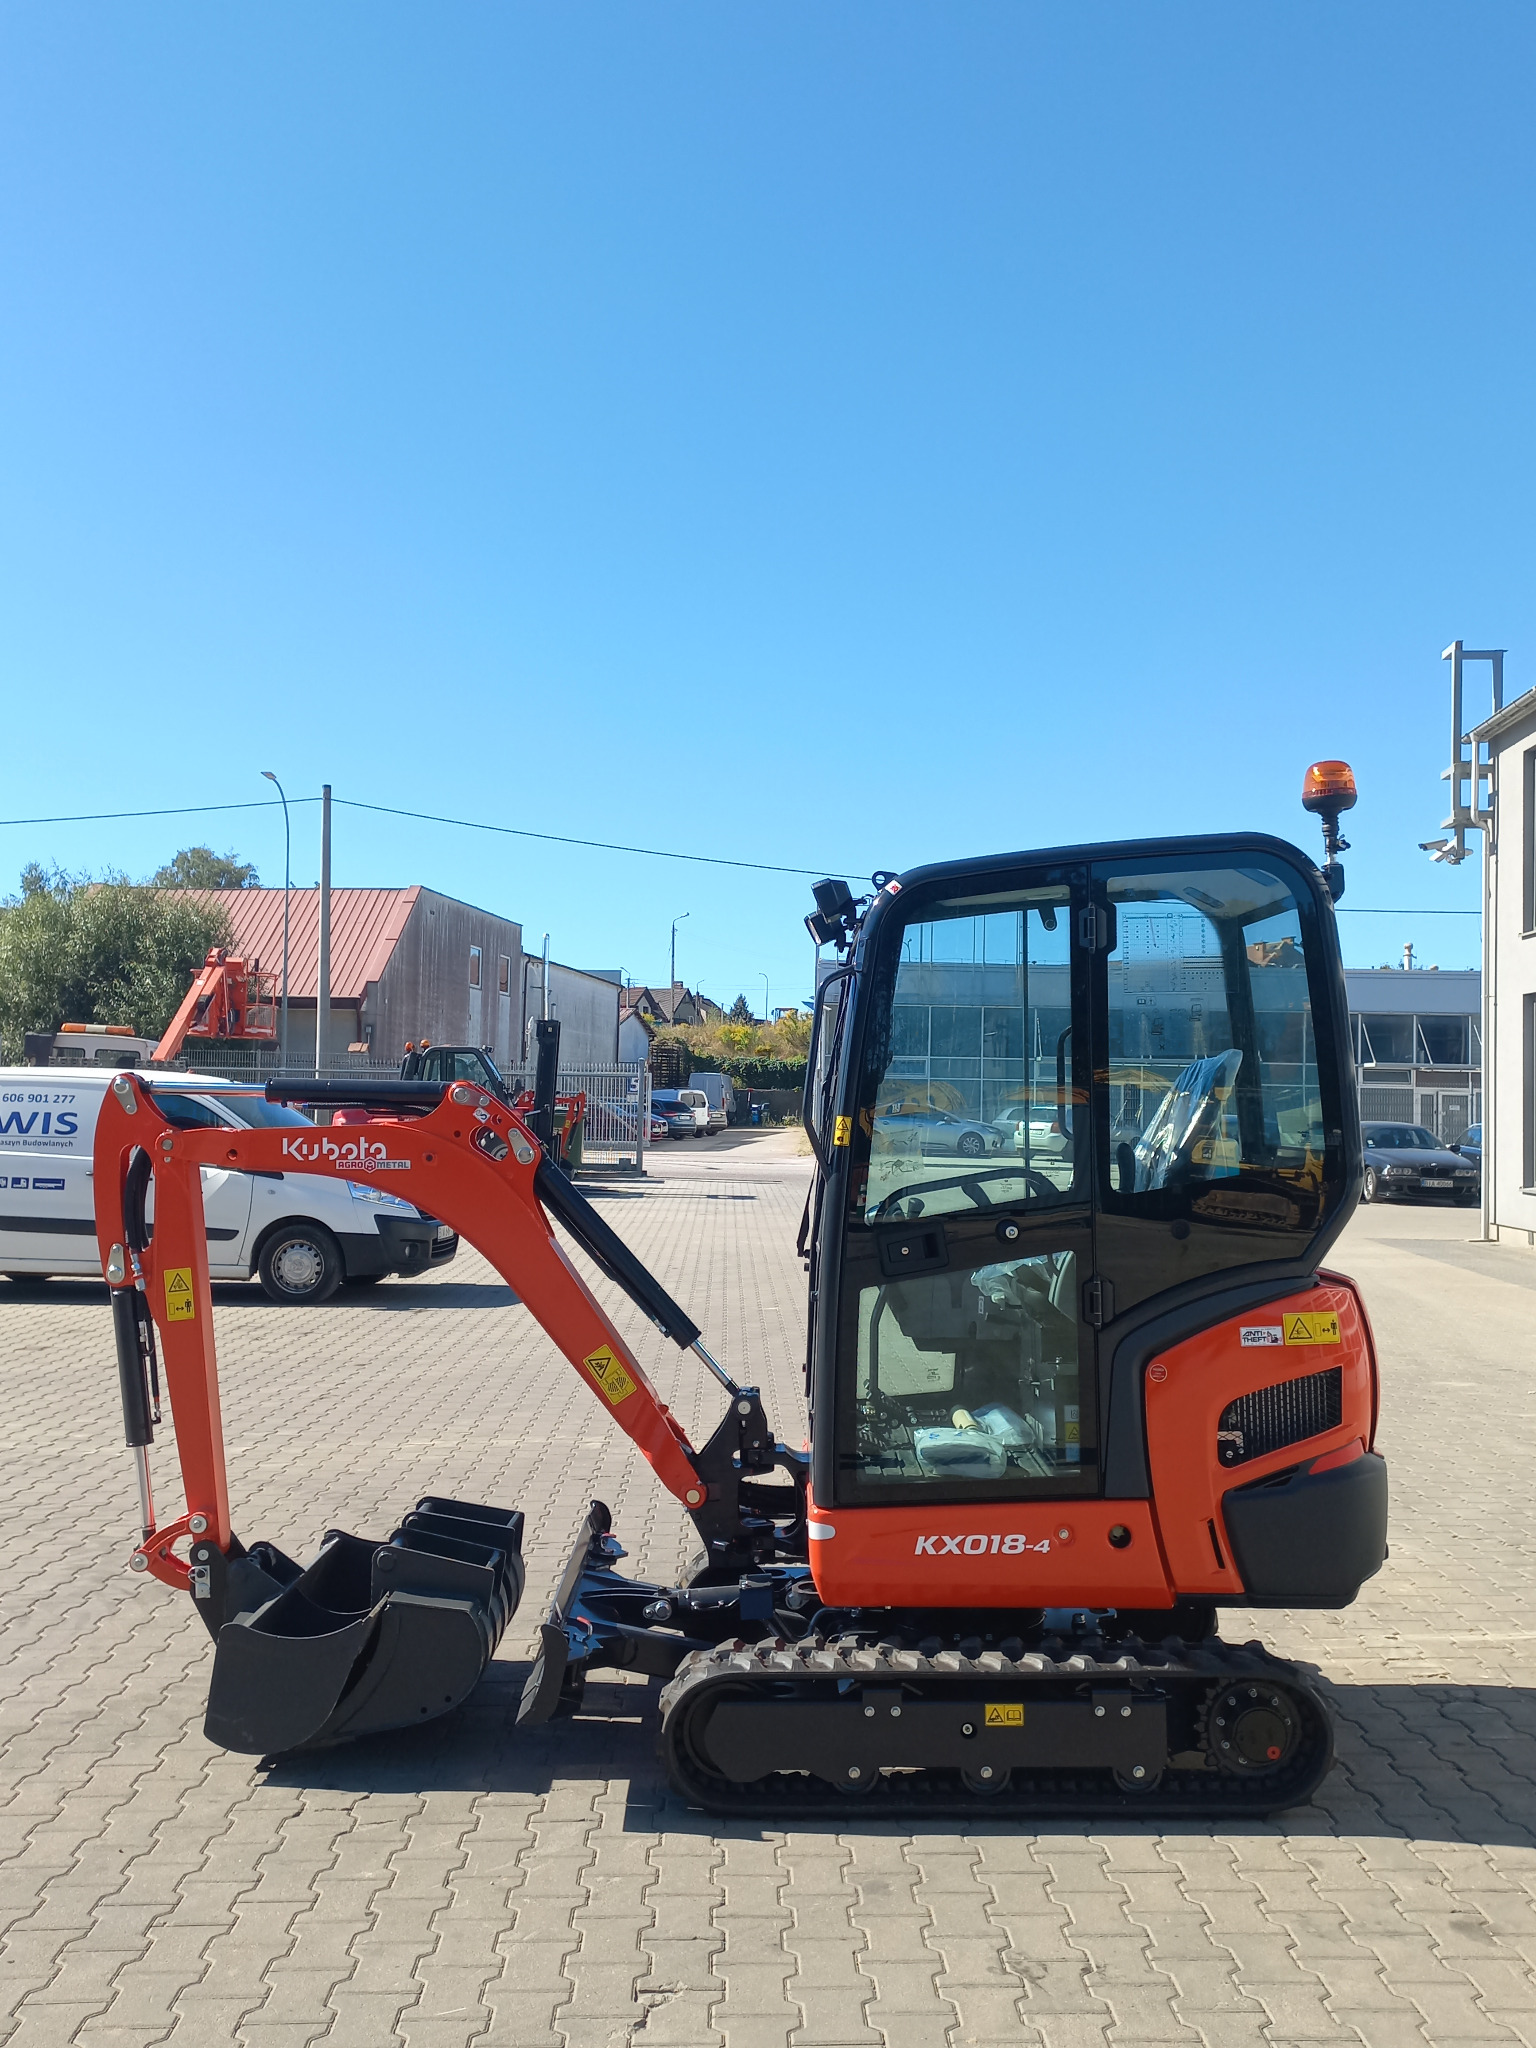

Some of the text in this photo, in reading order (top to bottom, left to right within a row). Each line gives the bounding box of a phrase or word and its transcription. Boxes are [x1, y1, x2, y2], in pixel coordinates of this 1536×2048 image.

[2, 1093, 76, 1104] 606 901 277
[0, 1111, 79, 1136] WIS
[22, 1139, 74, 1149] Budowlanych
[282, 1136, 388, 1161] Kubota
[338, 1161, 409, 1169] AGRO METAL
[914, 1534, 1051, 1555] KX018-4
